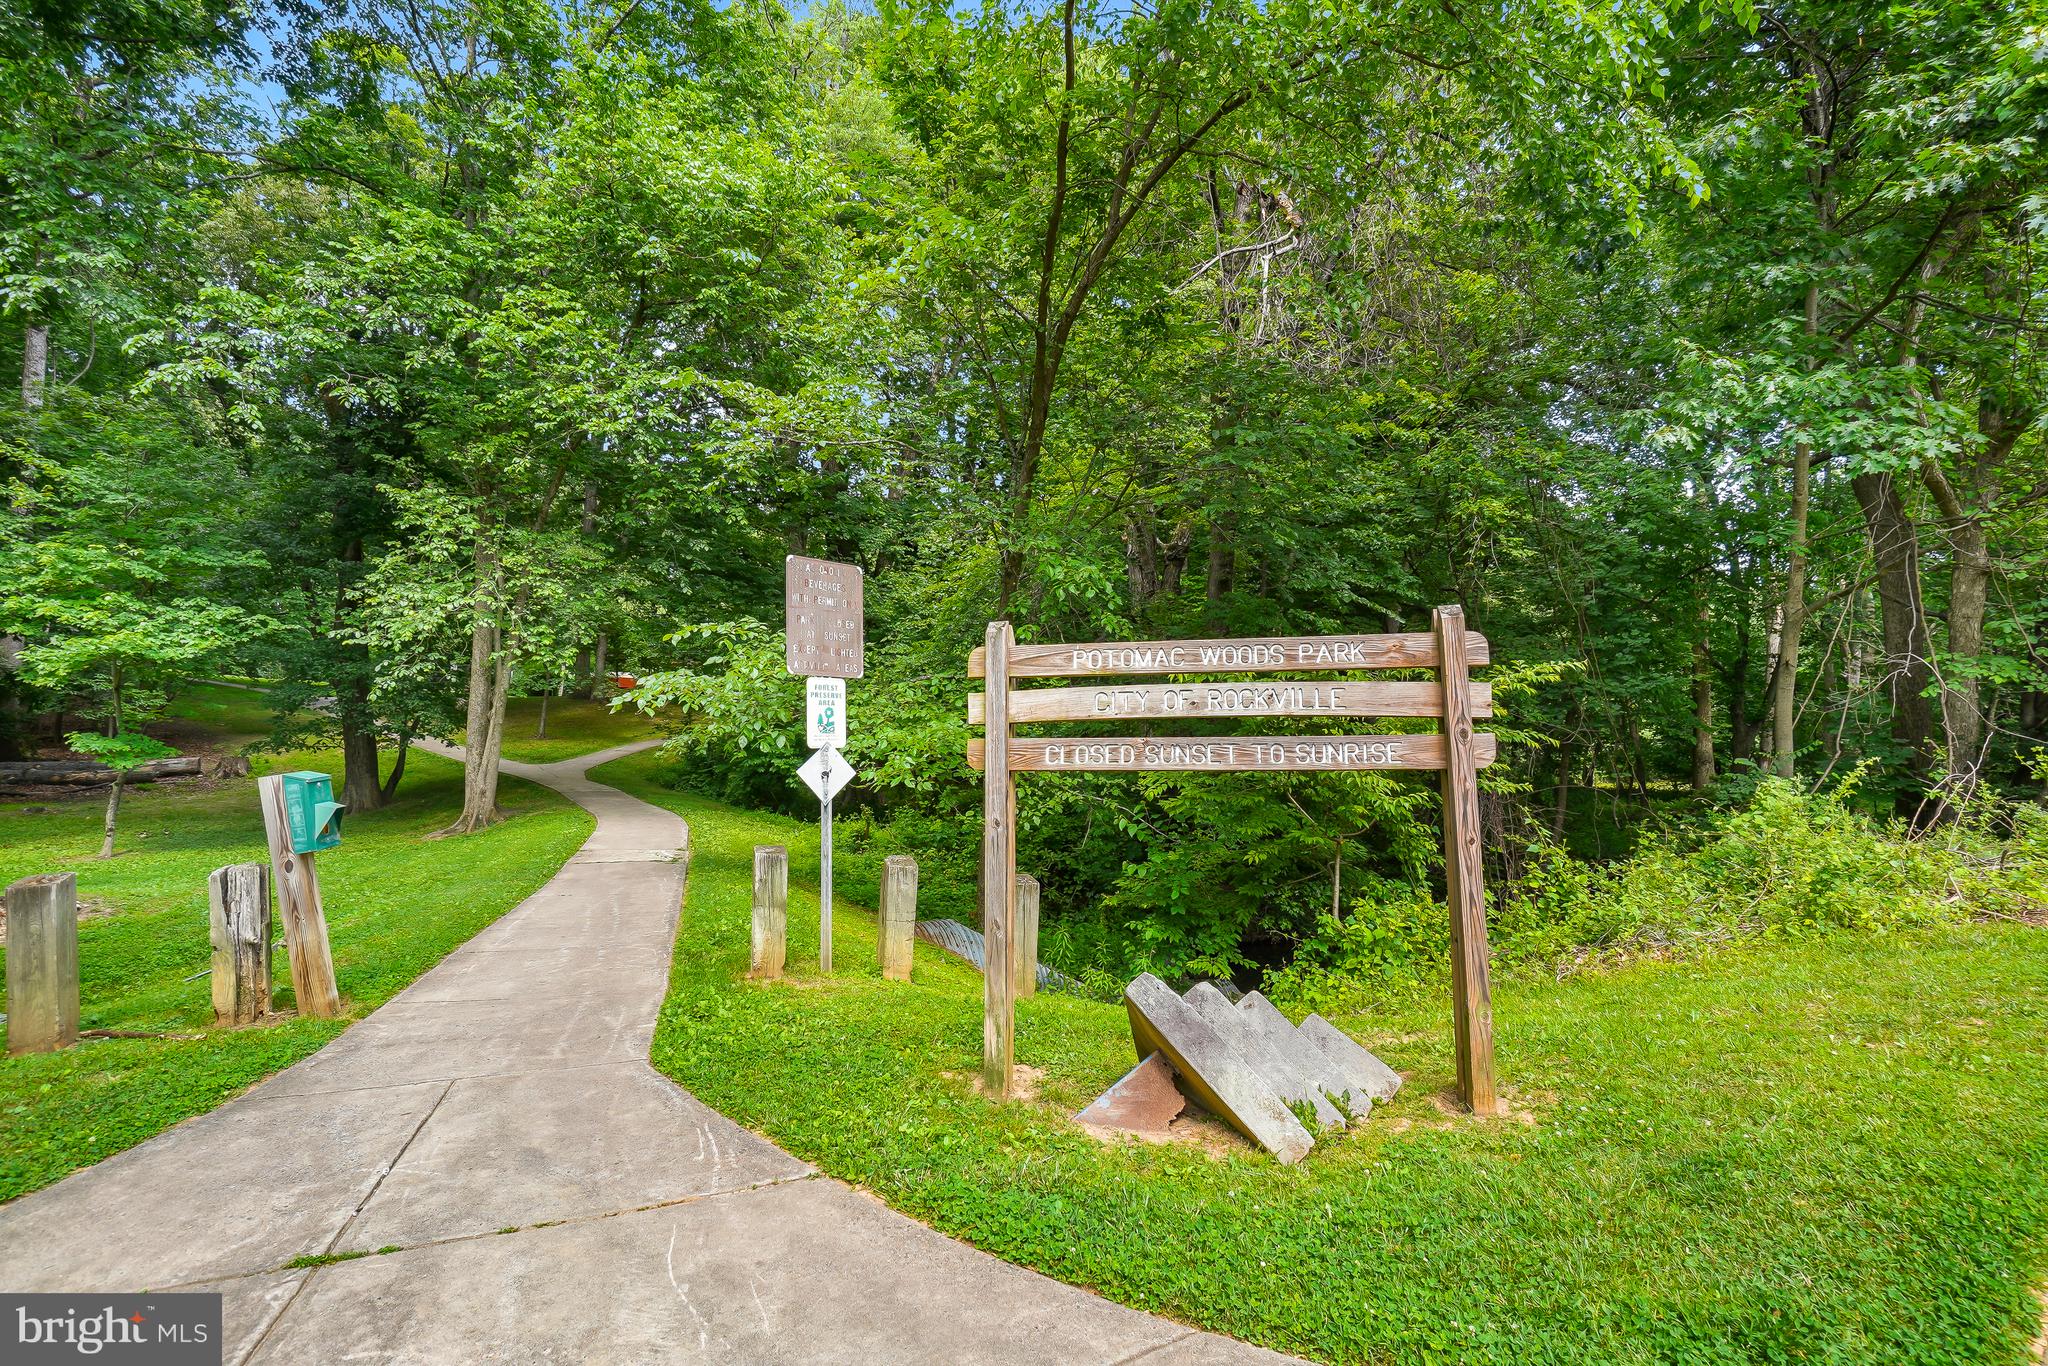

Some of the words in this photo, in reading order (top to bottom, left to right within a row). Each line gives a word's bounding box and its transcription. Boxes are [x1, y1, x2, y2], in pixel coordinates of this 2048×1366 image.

[804, 578, 846, 592] BEVERAGES
[824, 631, 850, 642] SUNSET
[1071, 647, 1185, 669] POTOMAC
[1200, 644, 1284, 666] WOODS
[1298, 641, 1366, 664] PARK
[810, 691, 842, 699] PRESERVE
[1094, 690, 1150, 712] CITY
[1163, 689, 1194, 711] OF
[1207, 687, 1346, 711] ROCKVILLE
[1044, 744, 1136, 766] CLOSED
[1143, 743, 1240, 766] SUNSET
[1250, 743, 1285, 764] TO
[1295, 741, 1403, 764] SUNRISE
